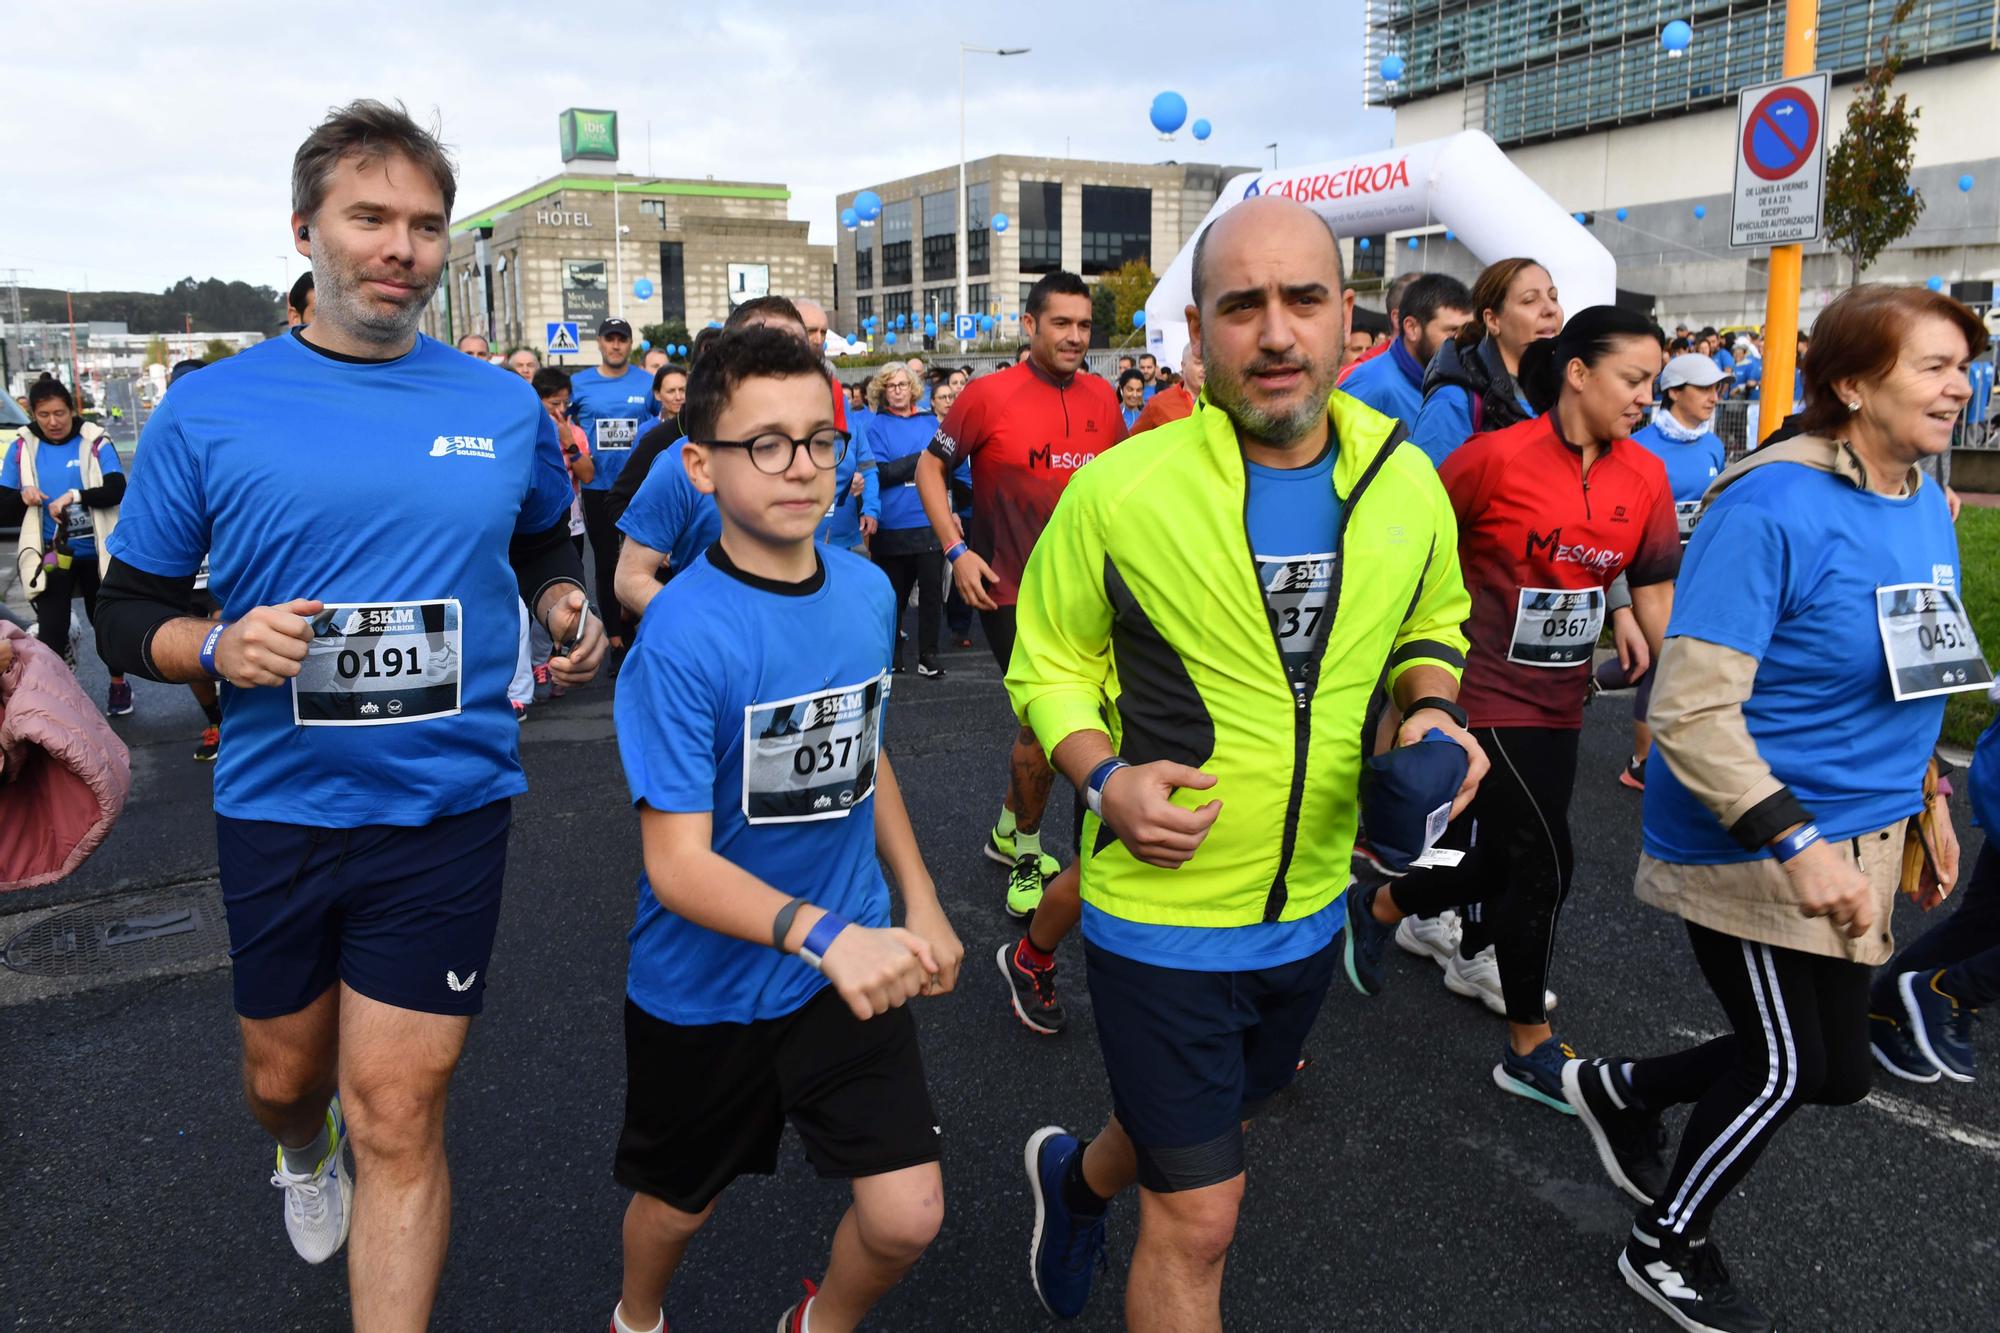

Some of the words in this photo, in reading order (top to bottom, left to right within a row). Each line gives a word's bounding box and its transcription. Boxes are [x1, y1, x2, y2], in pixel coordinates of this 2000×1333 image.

[1745, 187, 1754, 197] DE
[1755, 184, 1775, 195] LUNES
[1776, 183, 1781, 192] A
[1782, 180, 1809, 191] VIERNES
[1759, 197, 1768, 206] DE
[1773, 195, 1778, 204] A
[537, 211, 593, 226] HOTEL
[1761, 205, 1789, 218] EXCEPTO
[1770, 214, 1815, 227] AUTORIZADOS
[1746, 230, 1777, 241] ESTRELLA
[1777, 227, 1802, 238] GALICIA
[960, 316, 973, 337] P
[454, 435, 495, 452] 5KM
[369, 609, 415, 625] 5KM
[369, 624, 416, 632] SOLIDARIOS
[1543, 618, 1588, 637] 0367
[1918, 623, 1966, 651] 0451
[337, 647, 422, 679] 0191
[822, 692, 863, 716] 5KM
